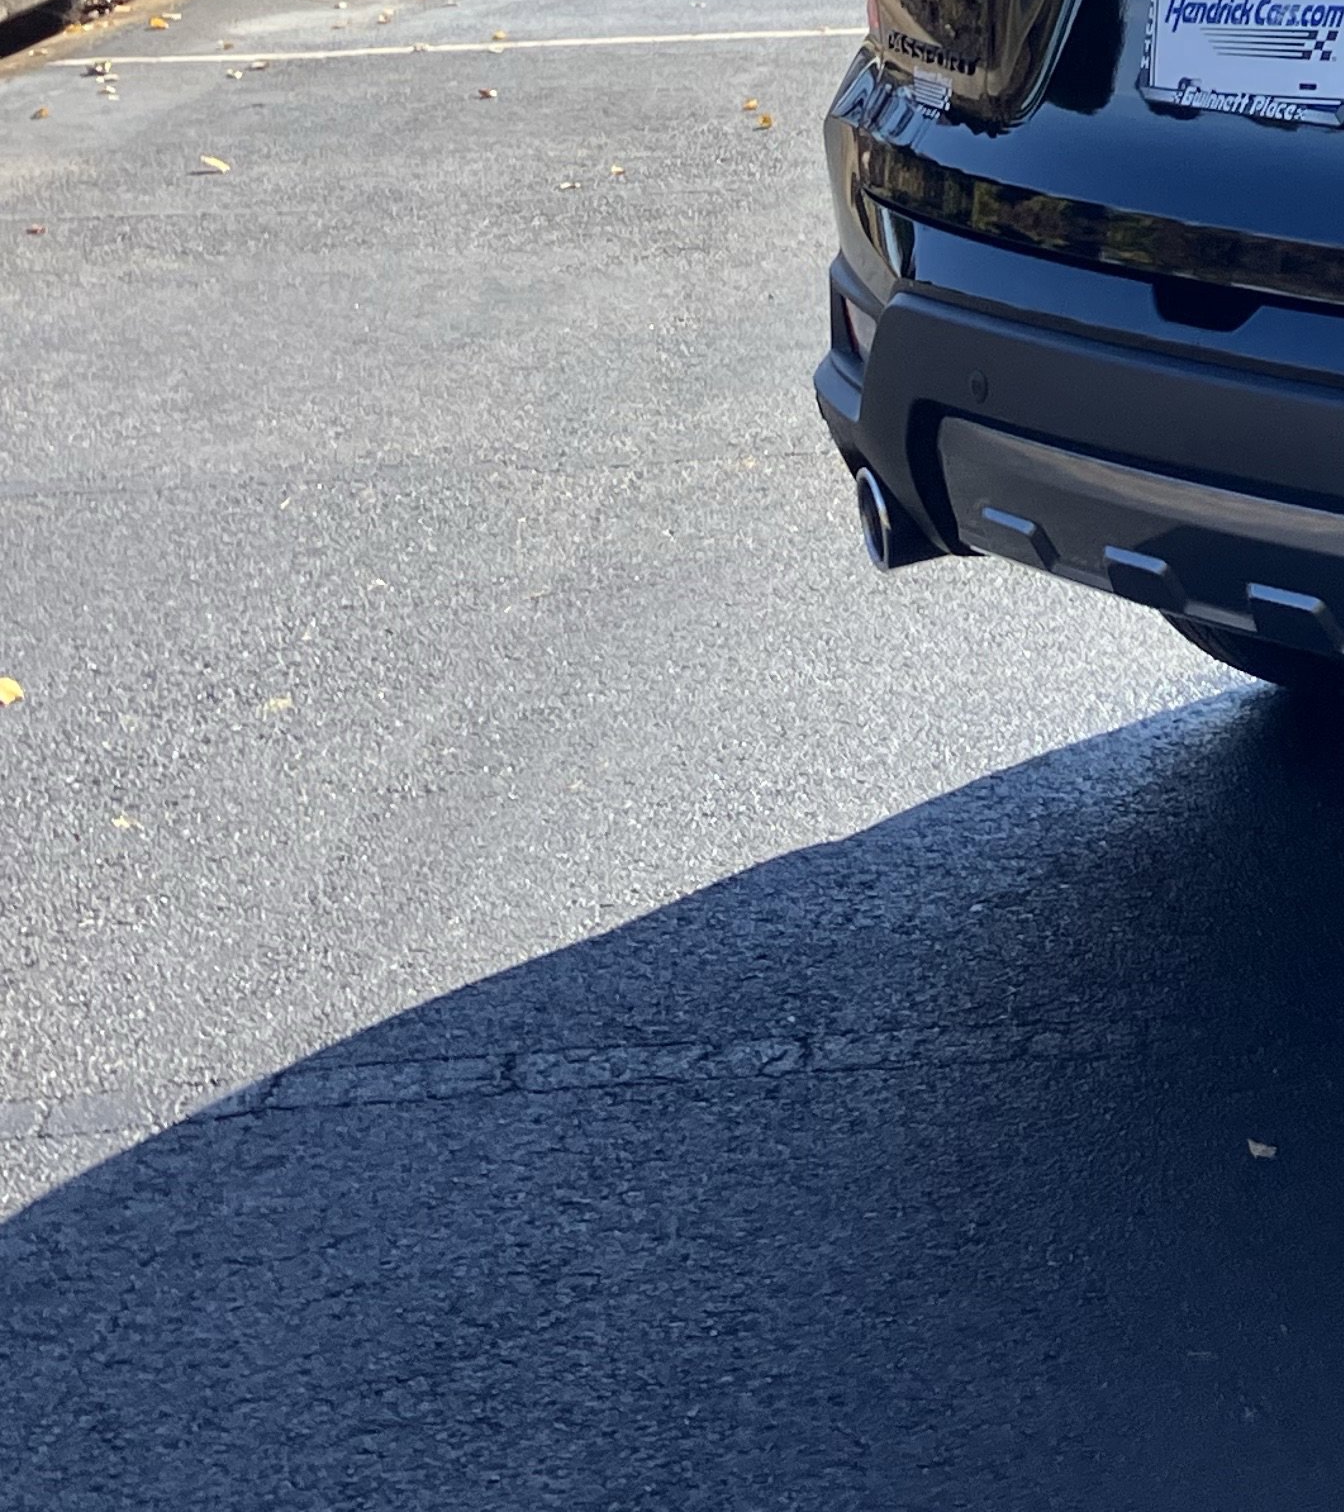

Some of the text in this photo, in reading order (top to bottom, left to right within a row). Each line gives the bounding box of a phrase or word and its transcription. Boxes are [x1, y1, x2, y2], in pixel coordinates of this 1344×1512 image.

[888, 29, 981, 76] PASSPORT
[1181, 86, 1297, 120] Gwinnett Place
